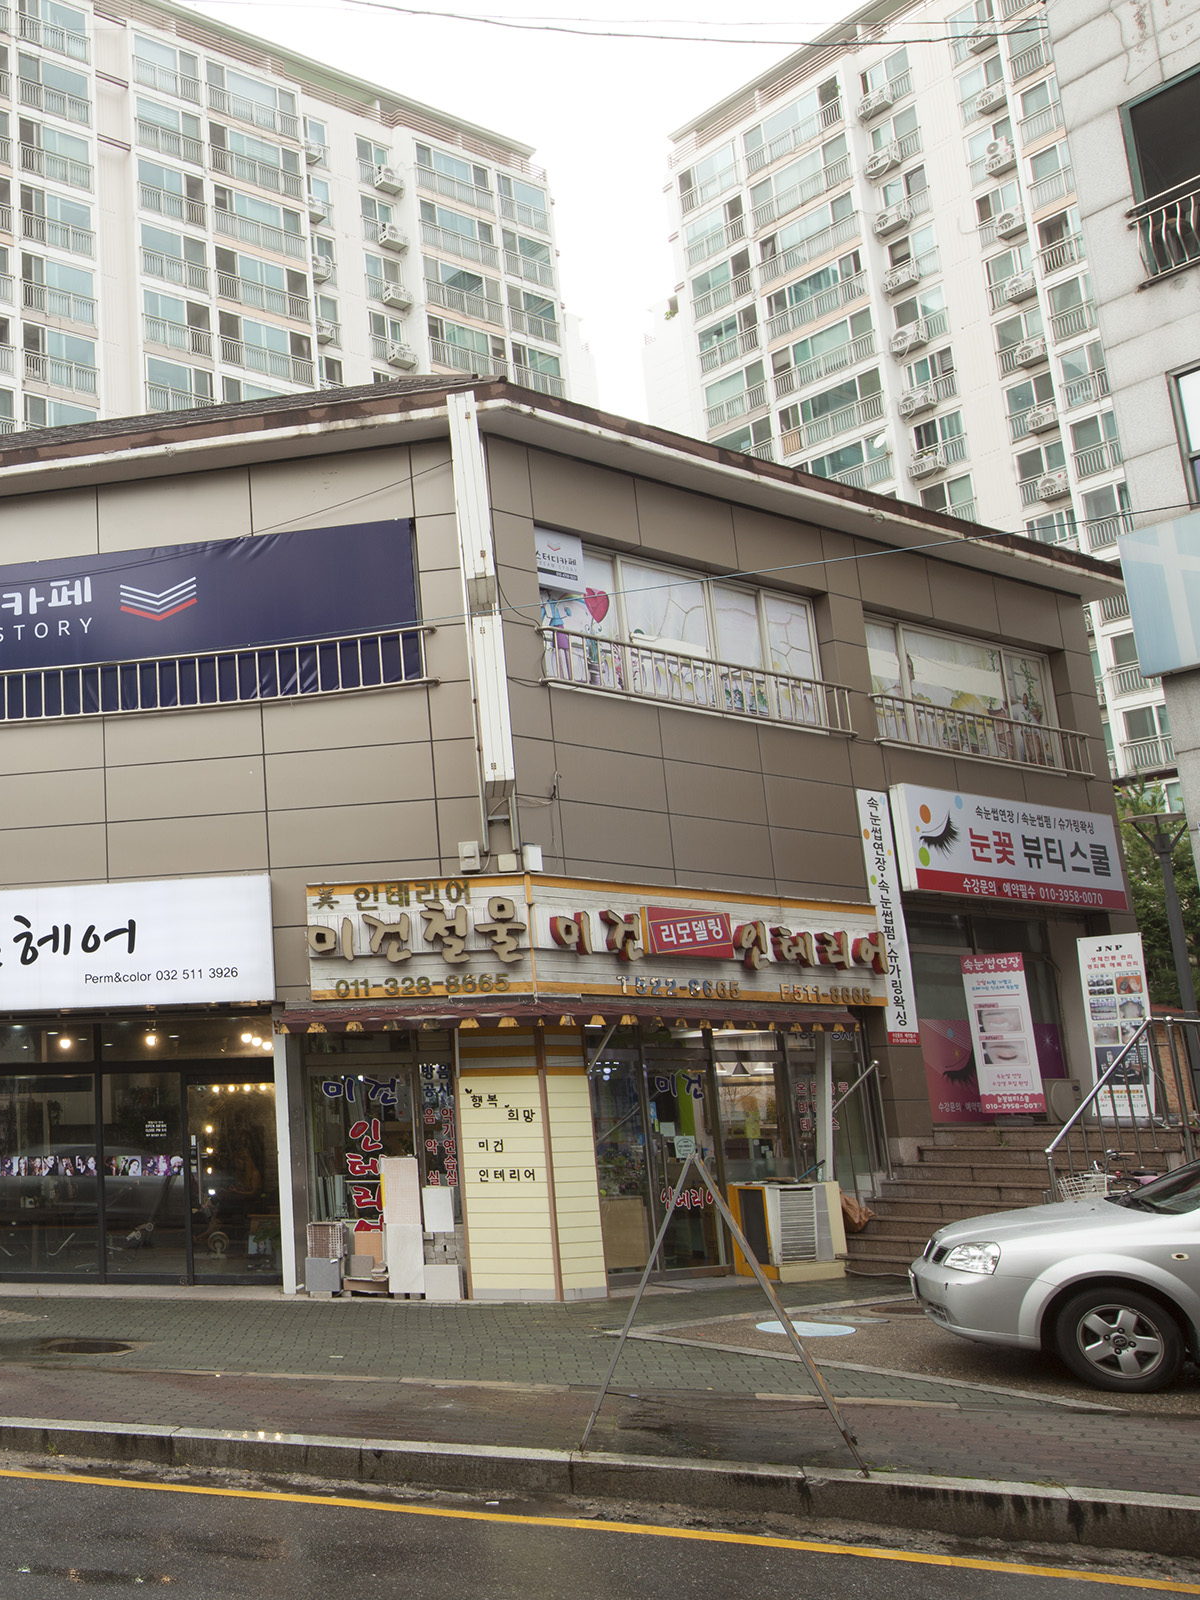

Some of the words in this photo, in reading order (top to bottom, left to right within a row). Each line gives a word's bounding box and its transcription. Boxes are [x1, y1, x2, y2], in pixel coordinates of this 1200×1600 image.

[975, 805, 1015, 824] 속눈썹연장
[1021, 812, 1051, 829] 속눈썹펌
[1058, 818, 1095, 835] 슈가링왁싱
[969, 827, 1016, 866] 눈꽃
[1021, 834, 1111, 878] 뷰티스쿨
[353, 880, 471, 911] 인테리어
[963, 877, 997, 895] 수강문의
[1003, 882, 1036, 900] 예약필수
[1039, 887, 1103, 905] 010-3958-0070
[307, 896, 527, 964] 미건철물
[550, 909, 644, 962] 미건
[660, 917, 723, 946] 리모델링
[733, 920, 889, 976] 인테리어
[1096, 944, 1123, 952] JNP
[84, 971, 152, 985] Perm&color
[155, 969, 178, 982] 032
[182, 968, 204, 980] 511
[208, 966, 239, 980] 3926
[963, 956, 1020, 970] 속눈썹연장
[335, 973, 509, 998] 011-328-8665
[420, 1064, 450, 1080] 방음
[322, 1076, 398, 1106] 미건
[422, 1082, 452, 1098] 공사
[655, 1073, 704, 1099] 미건
[470, 1094, 498, 1108] 행복
[938, 1102, 961, 1112] 수강문의
[507, 1109, 536, 1123] 희망
[478, 1139, 504, 1153] 미건
[478, 1169, 536, 1182] 인테리어
